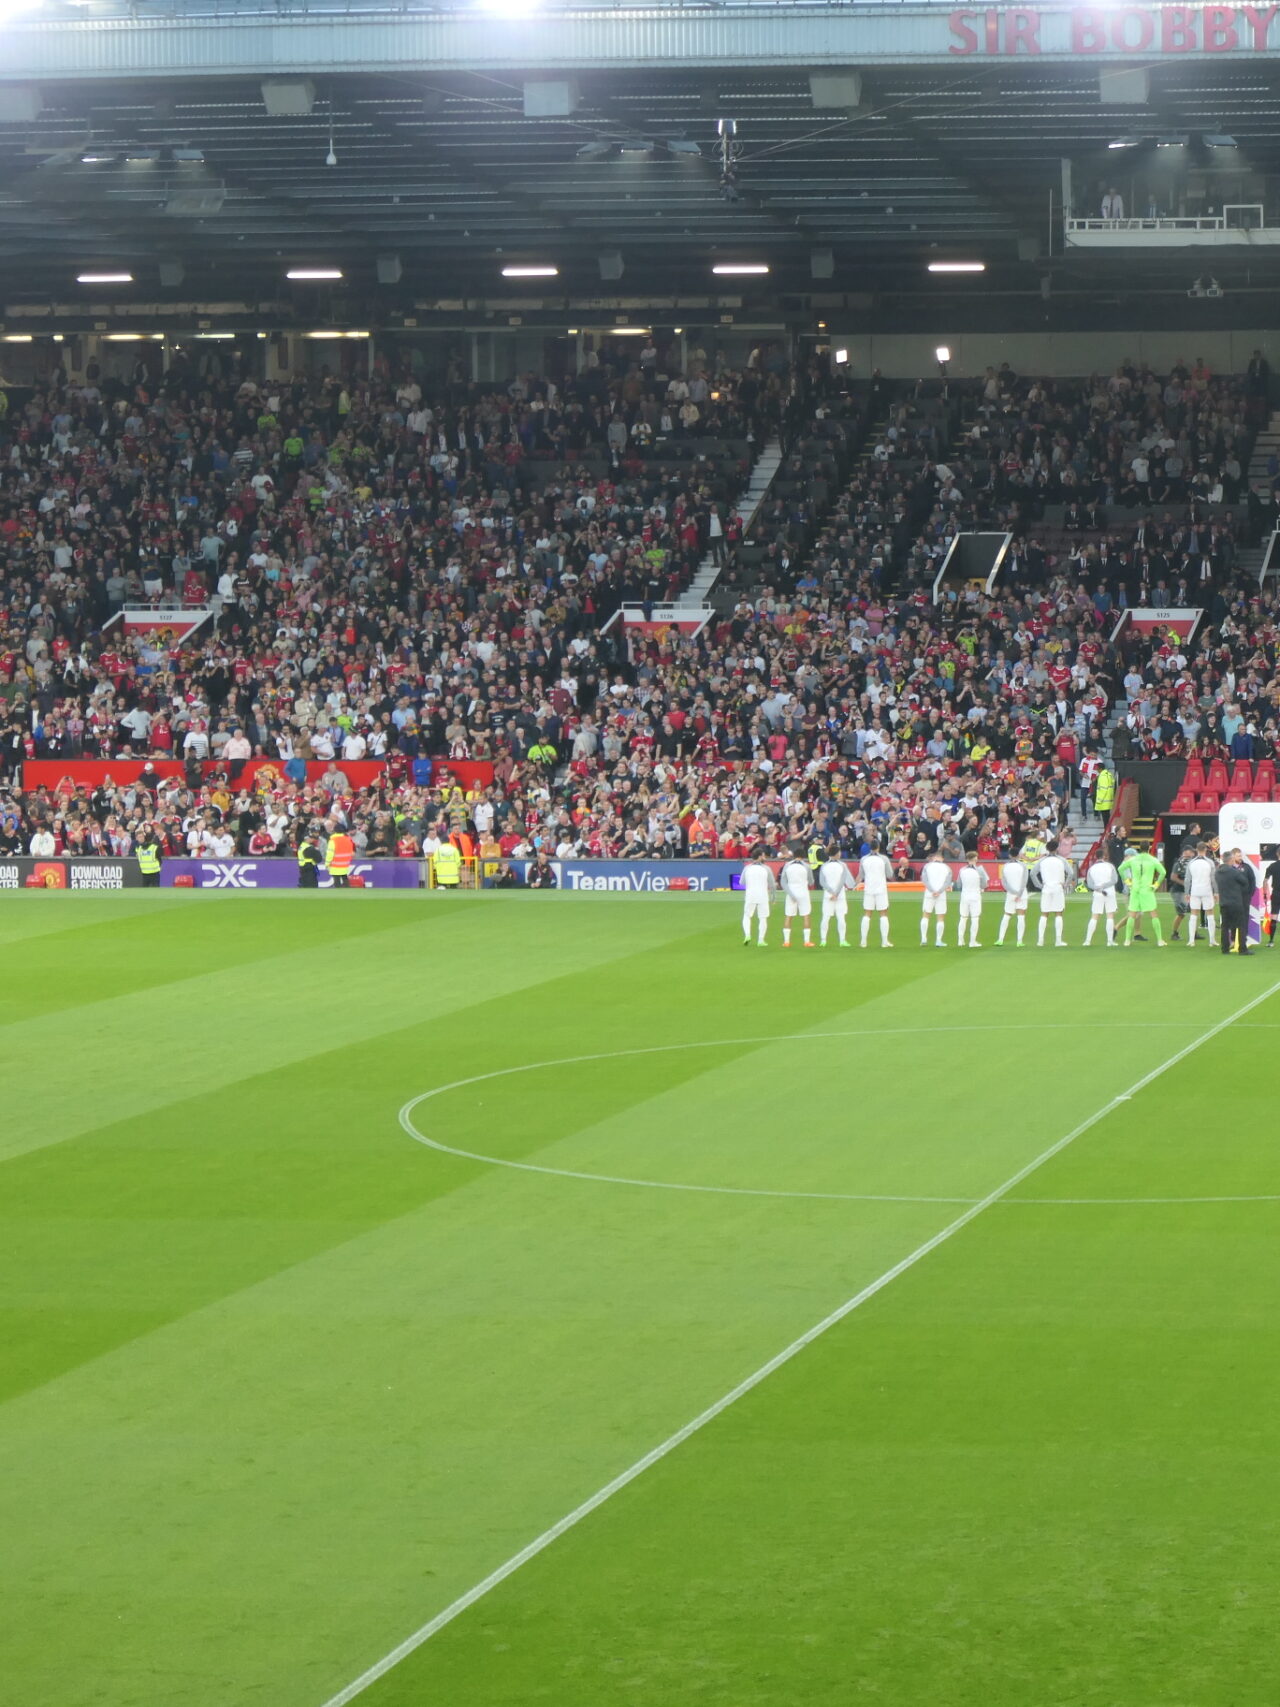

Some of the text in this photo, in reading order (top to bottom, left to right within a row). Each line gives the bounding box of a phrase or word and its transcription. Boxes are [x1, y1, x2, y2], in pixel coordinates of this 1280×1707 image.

[948, 9, 1041, 55] SIR
[1071, 4, 1278, 54] BOBBY
[71, 866, 123, 880] DOWNLOAD
[202, 864, 257, 887] DXC
[567, 871, 709, 892] TeamVieer
